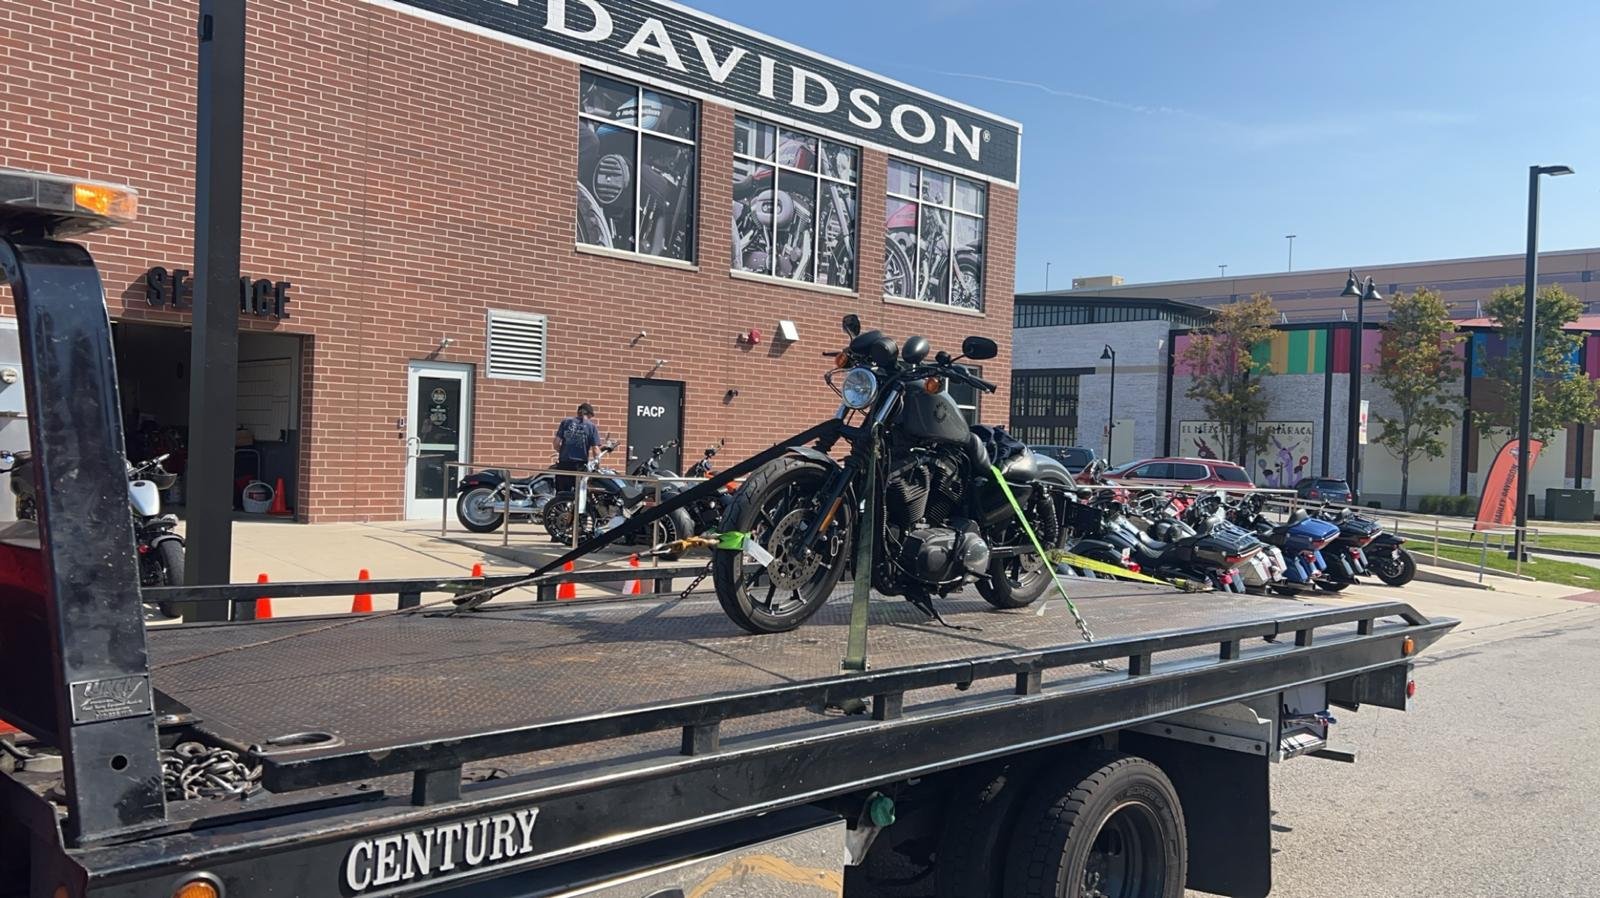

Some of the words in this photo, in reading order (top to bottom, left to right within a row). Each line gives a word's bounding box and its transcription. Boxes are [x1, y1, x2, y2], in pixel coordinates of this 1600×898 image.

[147, 266, 291, 319] SEICE
[636, 405, 665, 417] FACP
[346, 807, 540, 891] CENTURY
